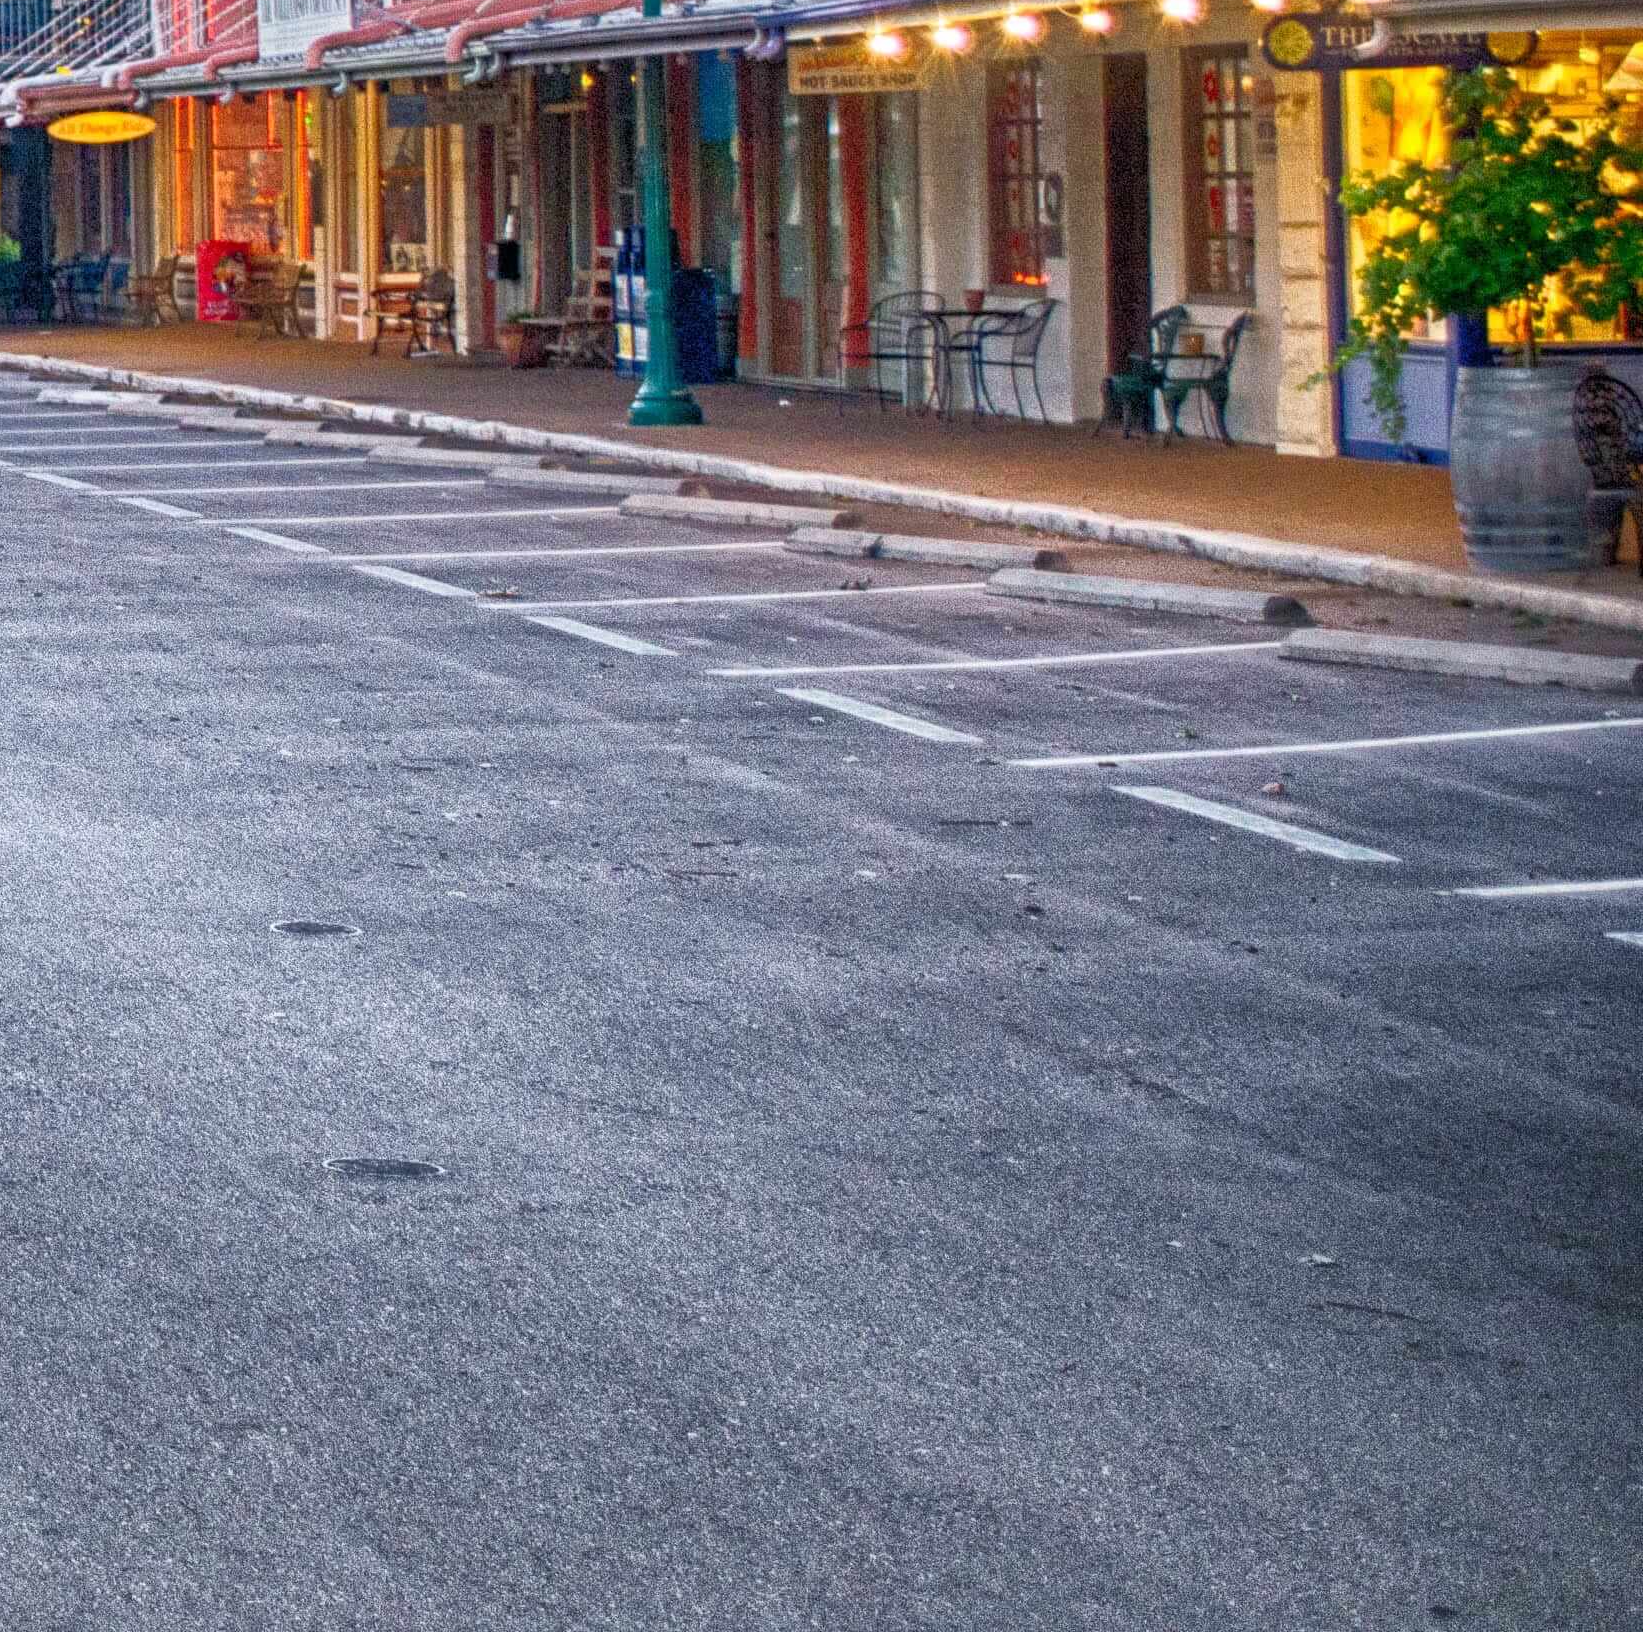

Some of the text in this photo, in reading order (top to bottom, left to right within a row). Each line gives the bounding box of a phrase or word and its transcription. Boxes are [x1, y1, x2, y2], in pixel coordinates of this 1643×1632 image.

[1322, 26, 1373, 48] THE
[800, 72, 917, 88] HOT SAUCE SHOP
